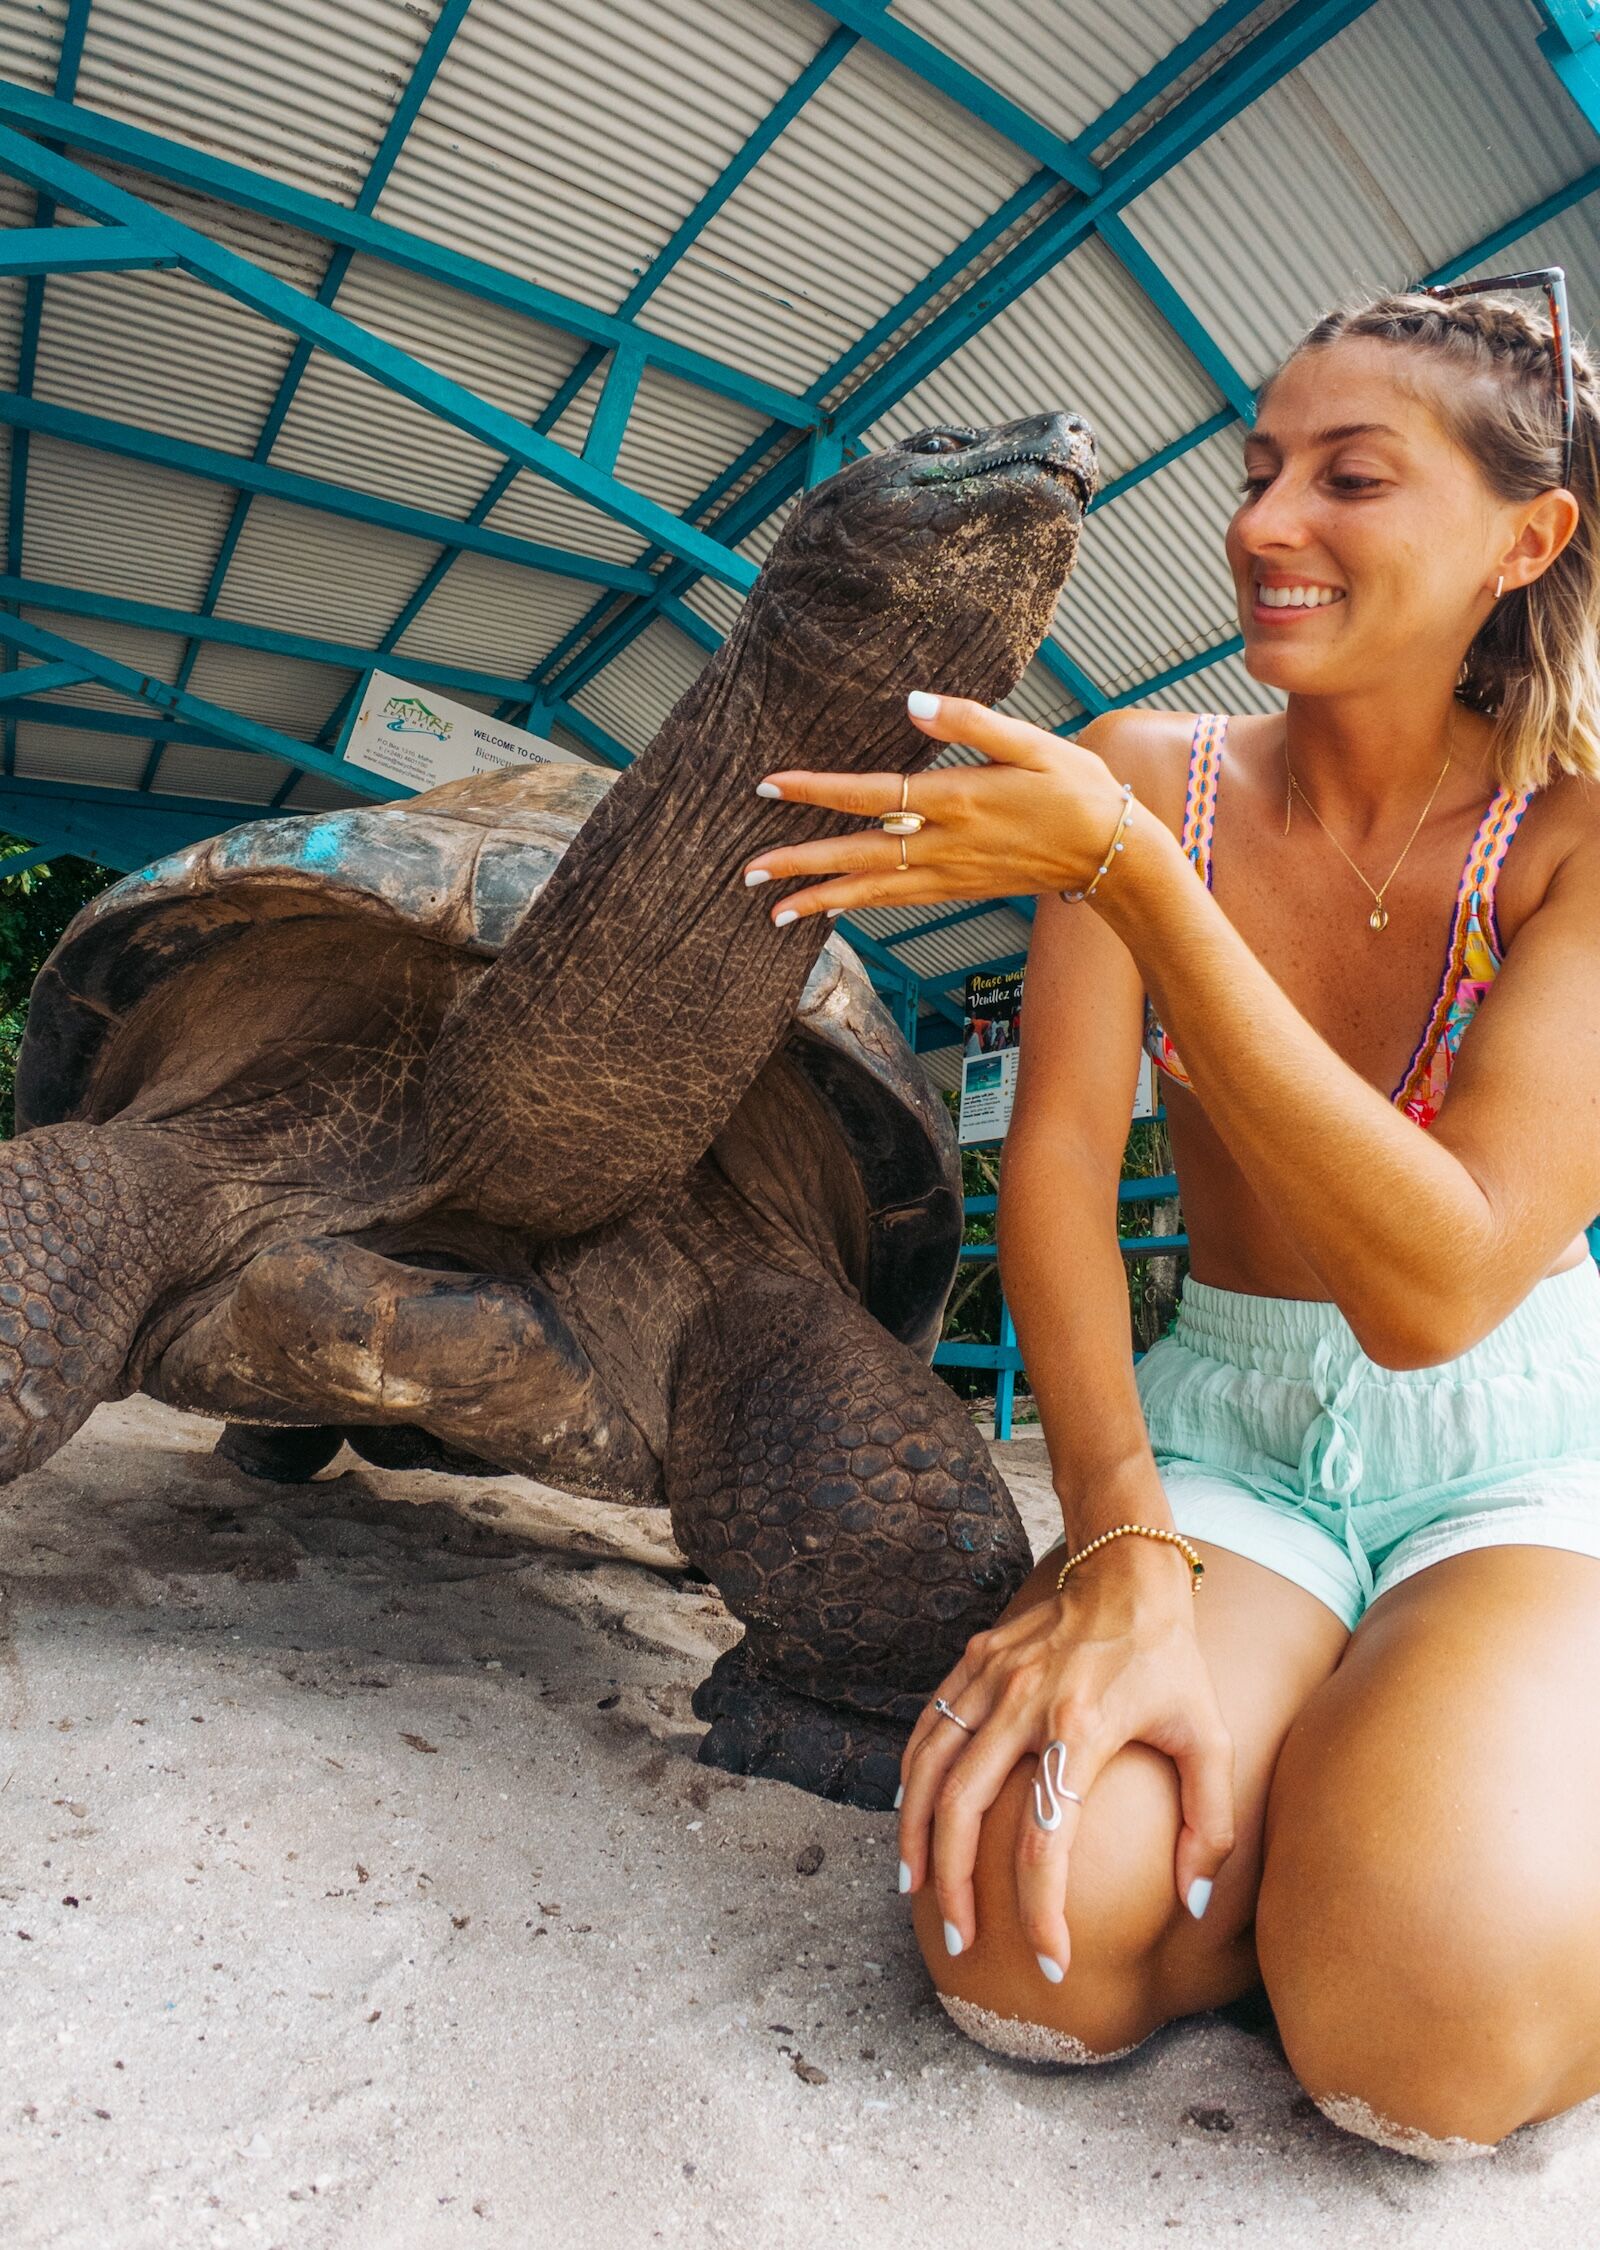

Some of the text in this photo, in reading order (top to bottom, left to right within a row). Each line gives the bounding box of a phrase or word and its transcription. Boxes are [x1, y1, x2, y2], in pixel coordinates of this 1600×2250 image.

[383, 700, 454, 733] NATURE
[473, 729, 515, 753] WELCOME
[517, 747, 528, 757] TO
[475, 747, 514, 768] Bienven
[971, 975, 1002, 991] Please
[968, 988, 1010, 1009] Veuillez
